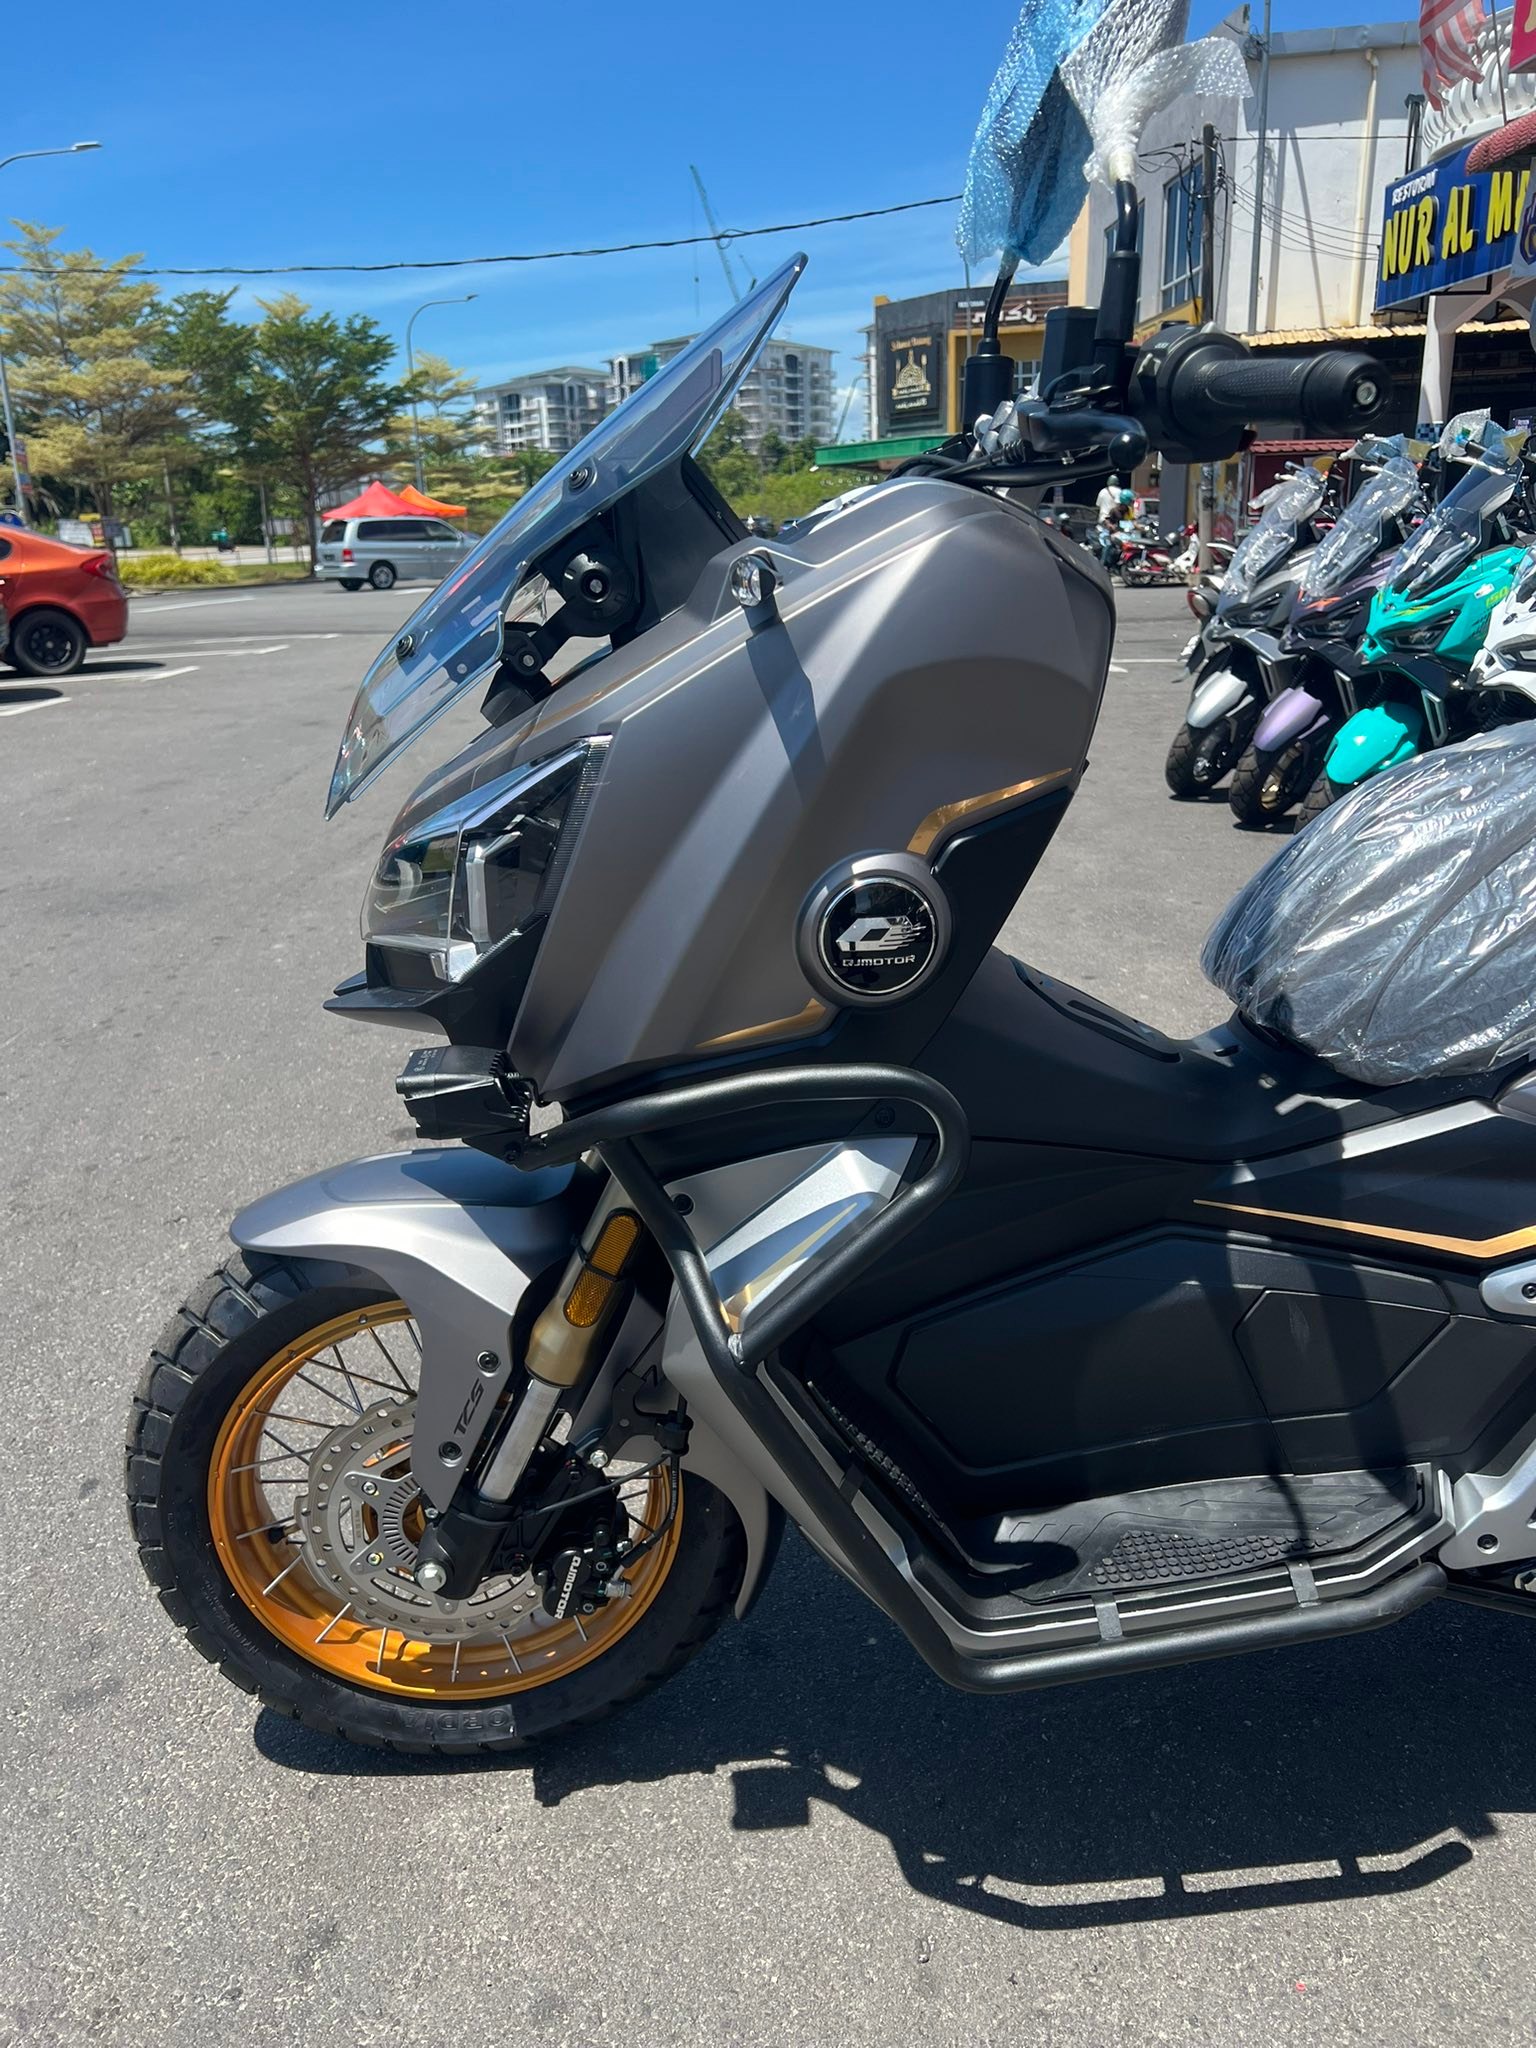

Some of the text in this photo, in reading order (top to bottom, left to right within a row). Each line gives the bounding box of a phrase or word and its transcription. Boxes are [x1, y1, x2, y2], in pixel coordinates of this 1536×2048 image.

[1382, 195, 1434, 281] NUR
[1441, 184, 1477, 260] AL
[842, 954, 916, 967] QJMOTOR
[554, 1554, 582, 1620] QJMOTOR
[379, 1703, 512, 1731] ORDIAL
